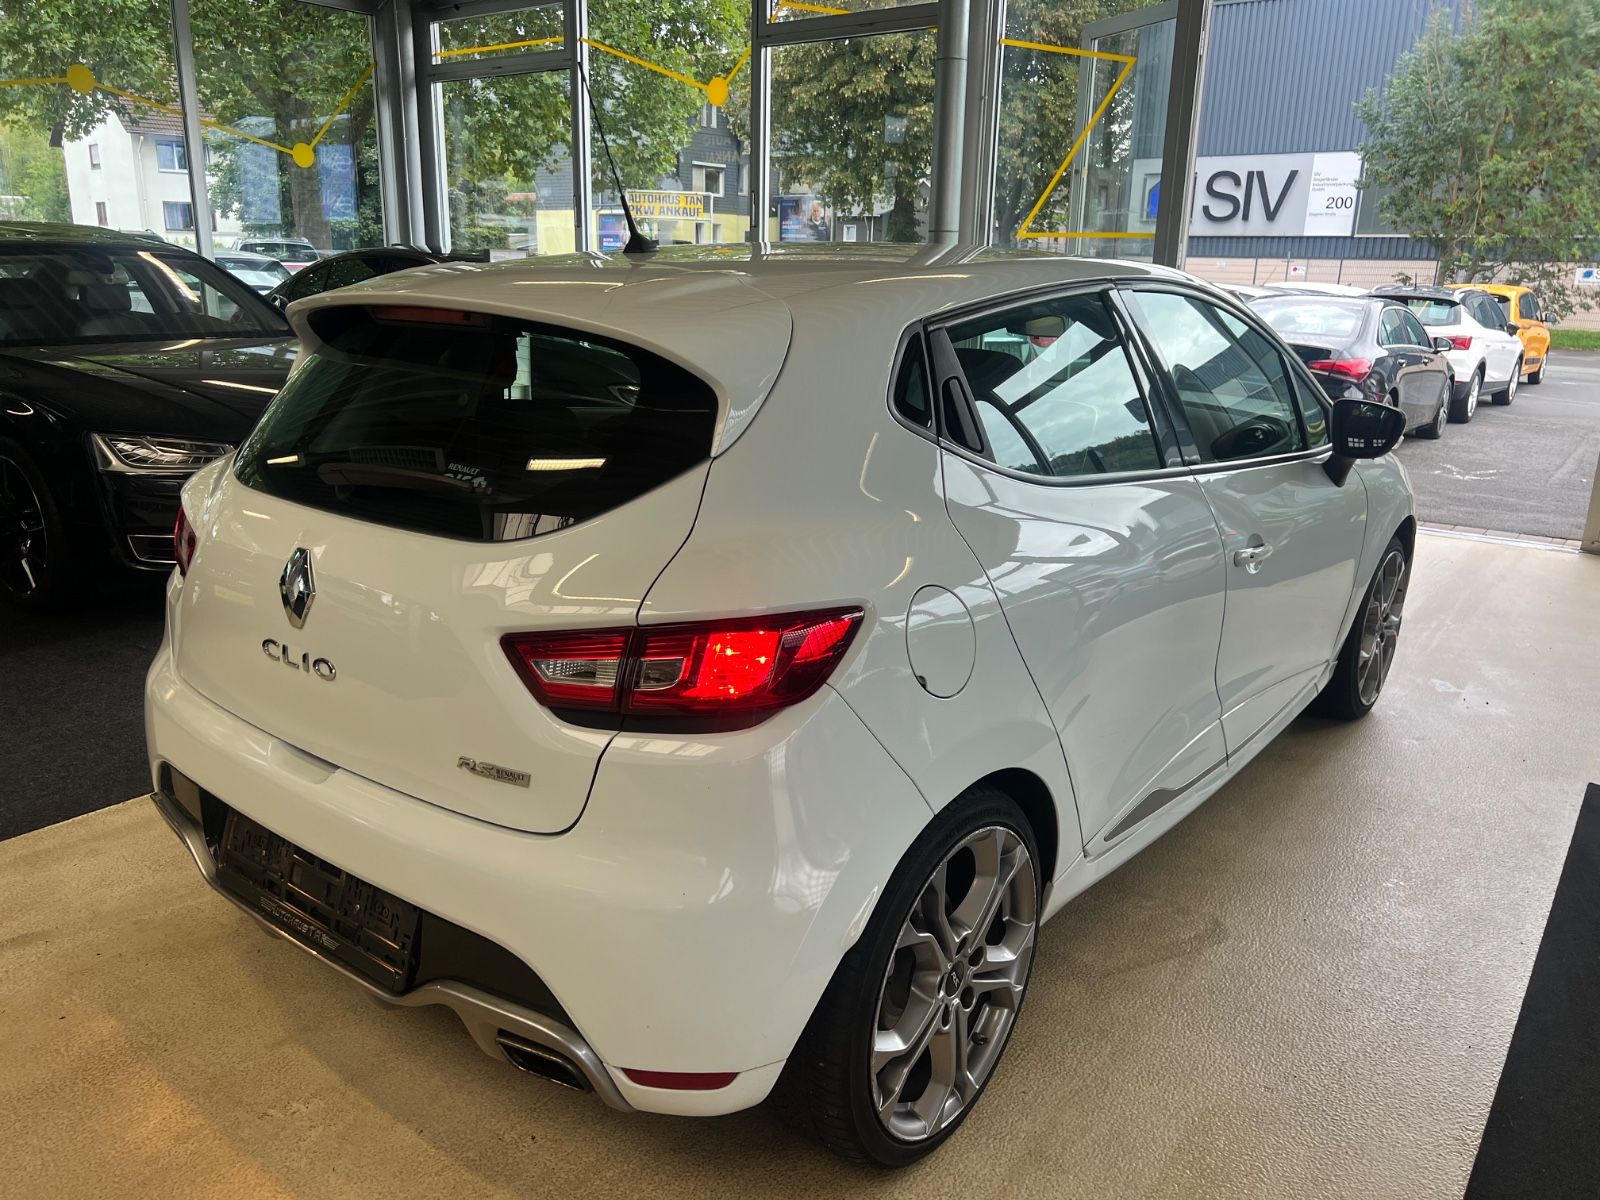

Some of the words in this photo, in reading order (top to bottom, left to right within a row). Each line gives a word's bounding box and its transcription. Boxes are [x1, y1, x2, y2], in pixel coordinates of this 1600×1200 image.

[629, 192, 681, 205] AUTOHAUS
[684, 194, 703, 205] TAN
[1203, 170, 1298, 223] SIV
[1326, 196, 1353, 210] 200
[659, 206, 702, 217] ANKAUF
[448, 462, 481, 475] RENAULT
[261, 638, 337, 681] CLIO
